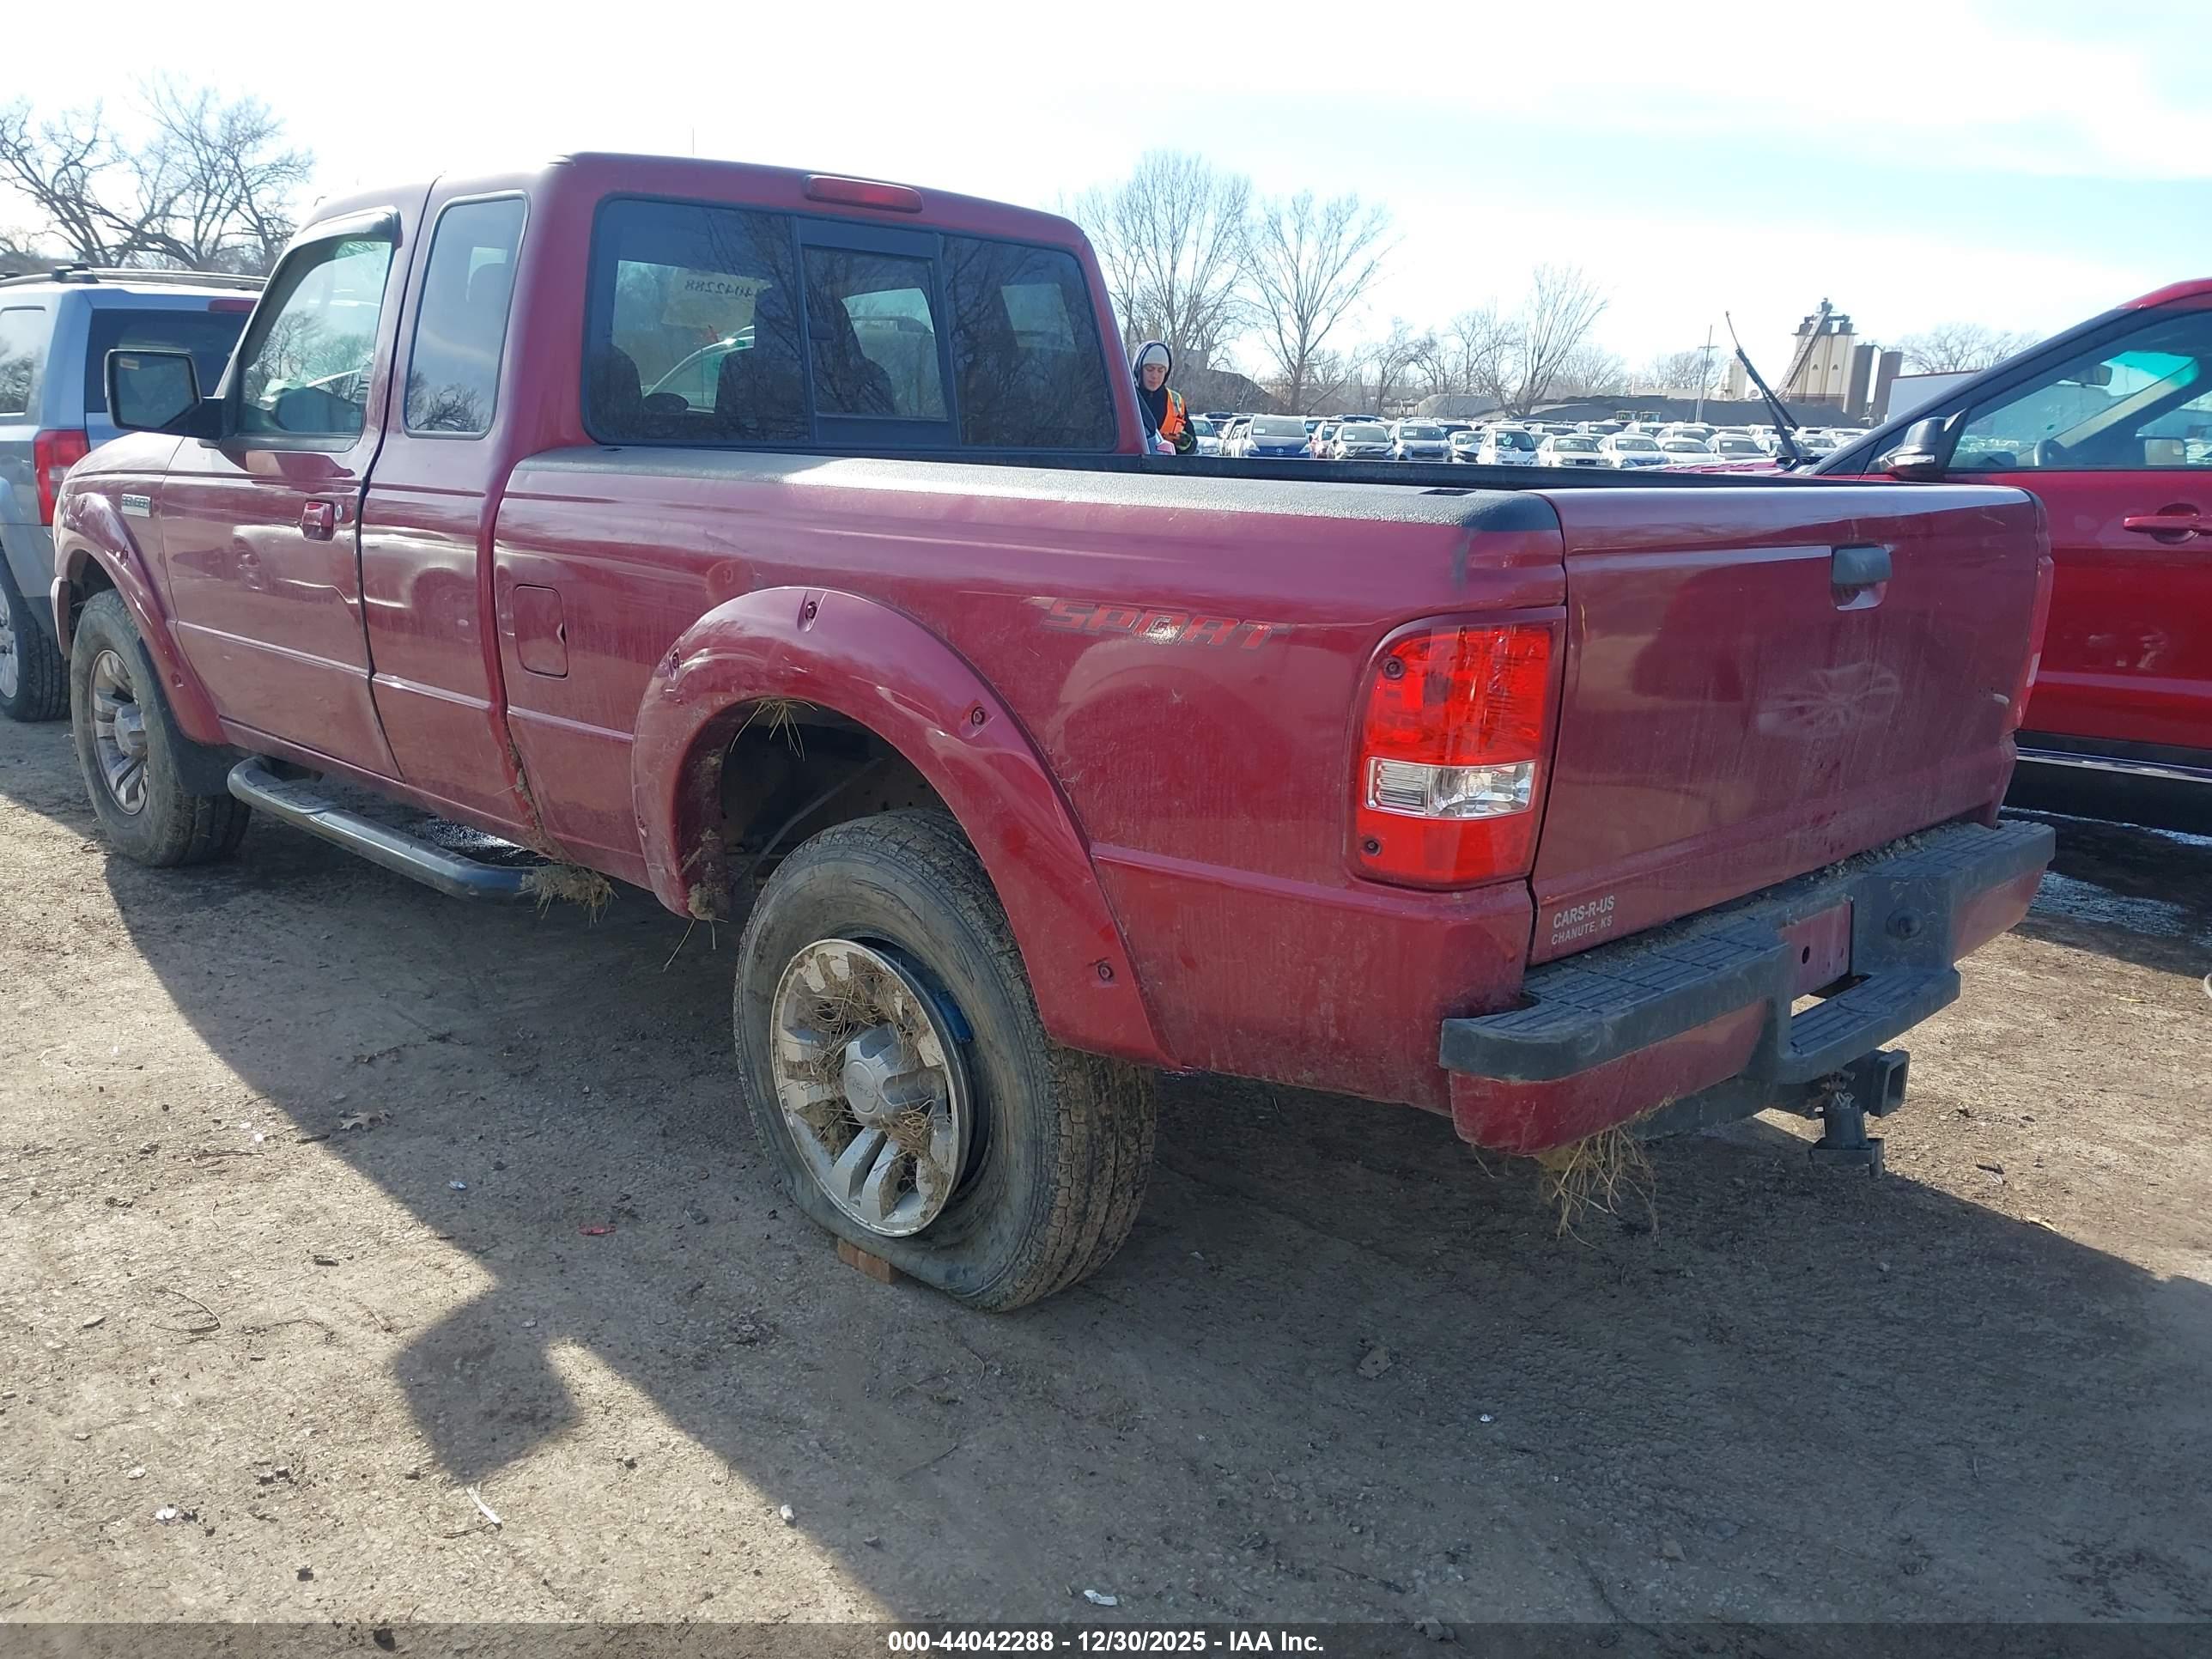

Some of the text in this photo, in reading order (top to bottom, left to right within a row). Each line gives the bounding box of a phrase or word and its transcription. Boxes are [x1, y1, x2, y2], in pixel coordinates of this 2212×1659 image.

[1042, 599, 1275, 650] SPORT
[1553, 895, 1615, 929] CARS-R-US
[1600, 915, 1613, 928] KS
